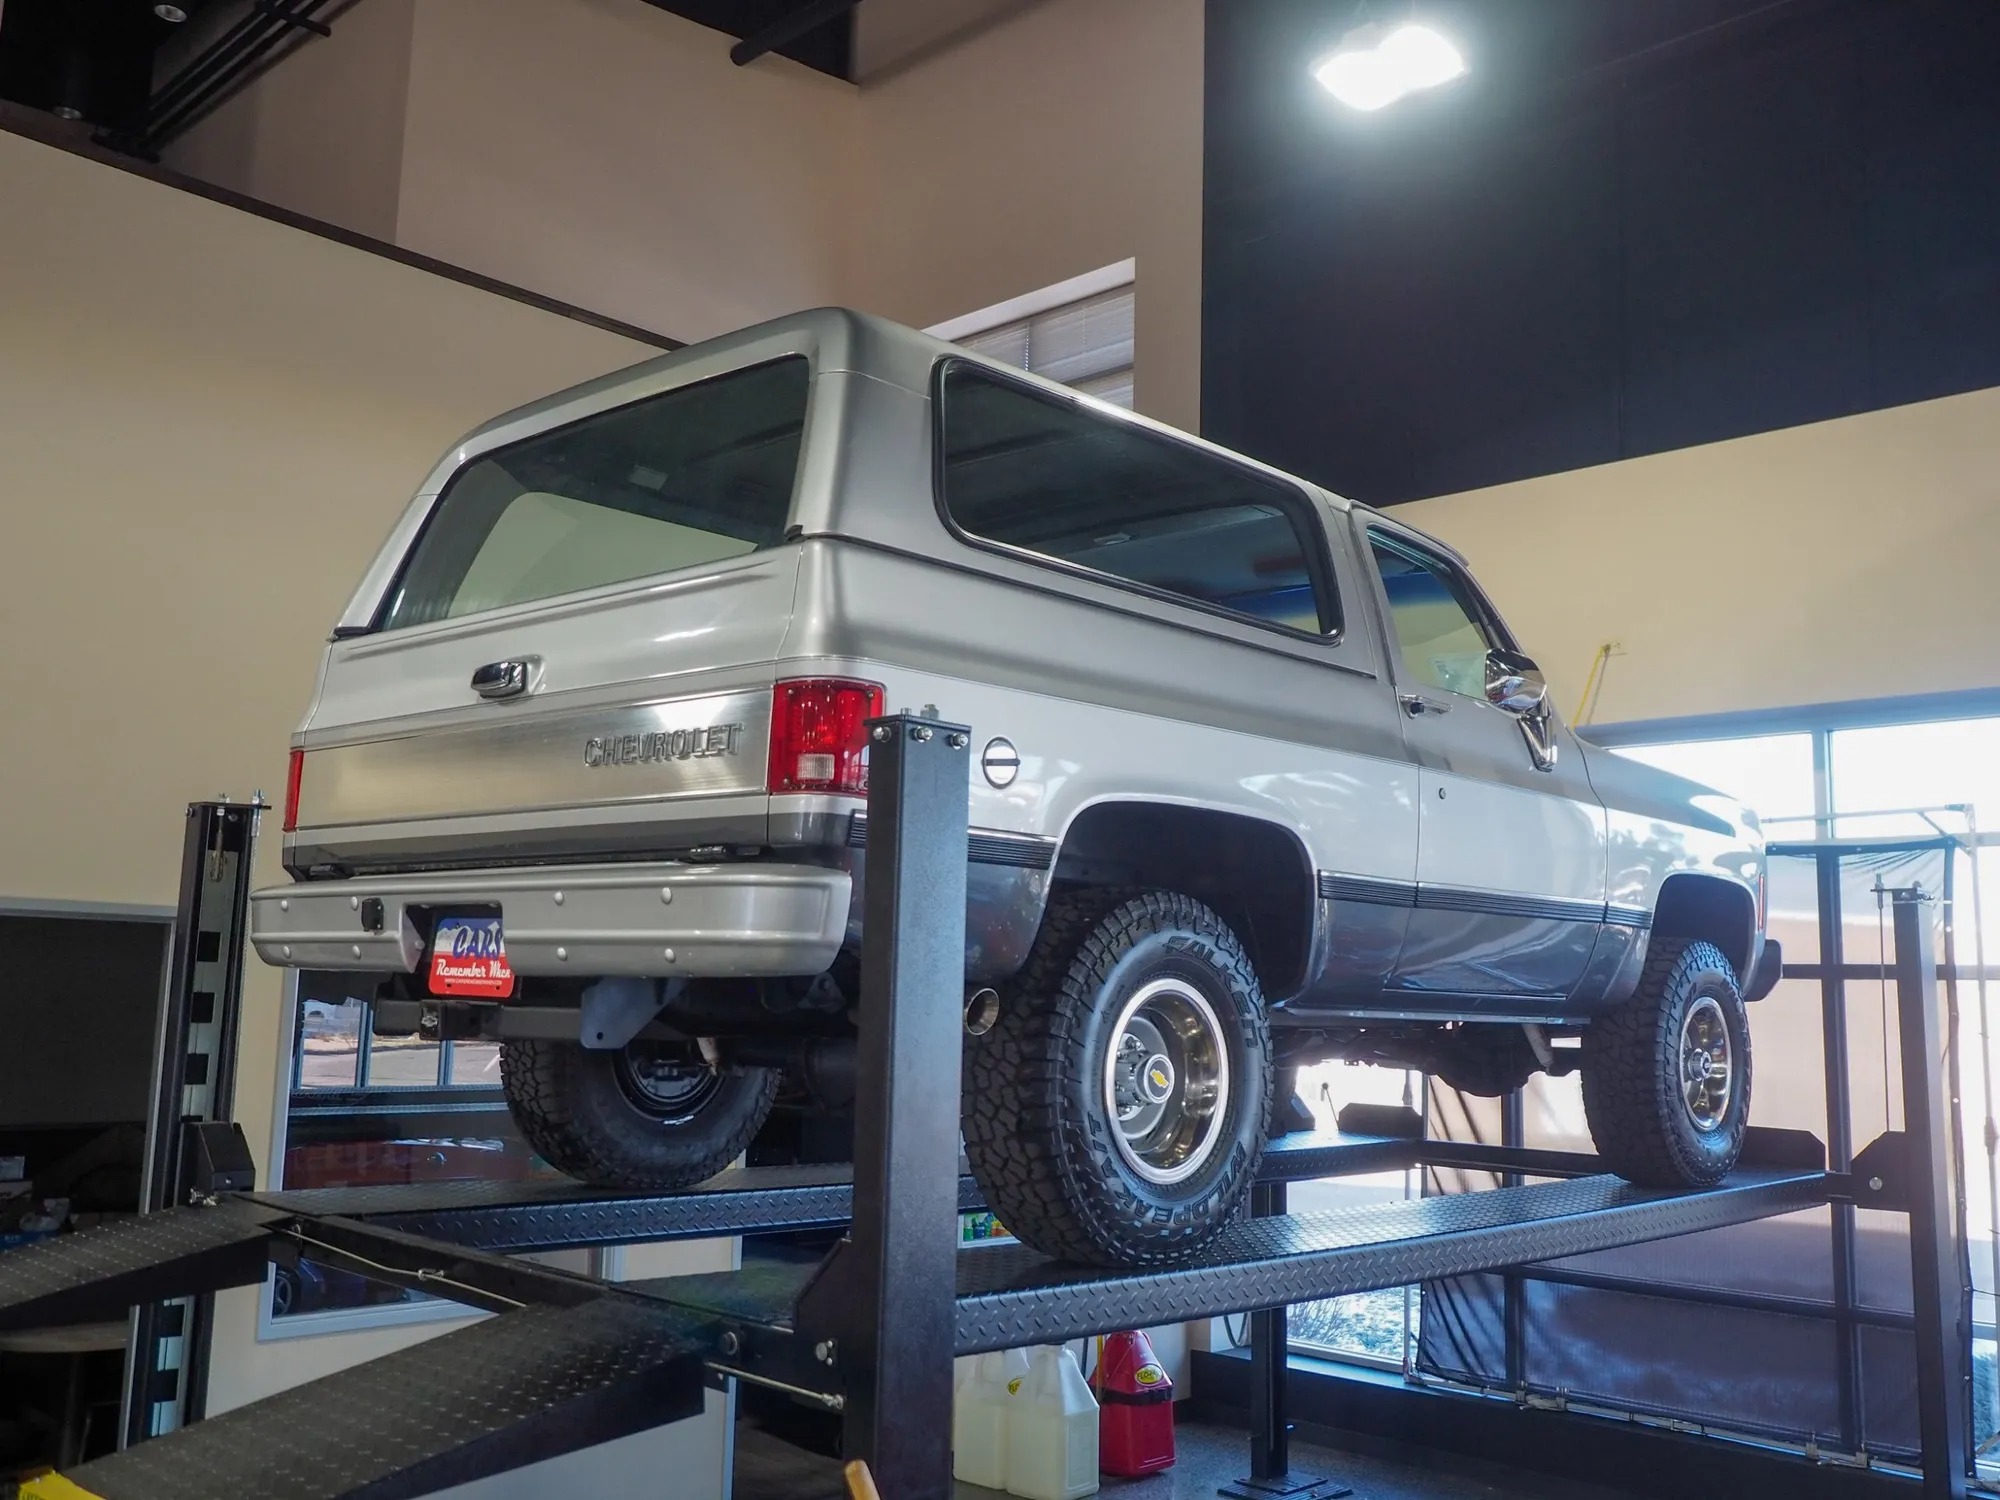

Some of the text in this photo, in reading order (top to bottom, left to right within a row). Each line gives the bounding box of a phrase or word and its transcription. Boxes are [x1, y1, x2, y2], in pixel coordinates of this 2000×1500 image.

[584, 722, 745, 767] CHEVROLET
[453, 925, 503, 960] CARS
[436, 958, 511, 979] Remember When
[1162, 935, 1259, 1049] FALKEN
[1114, 1141, 1247, 1226] WILDPEAK
